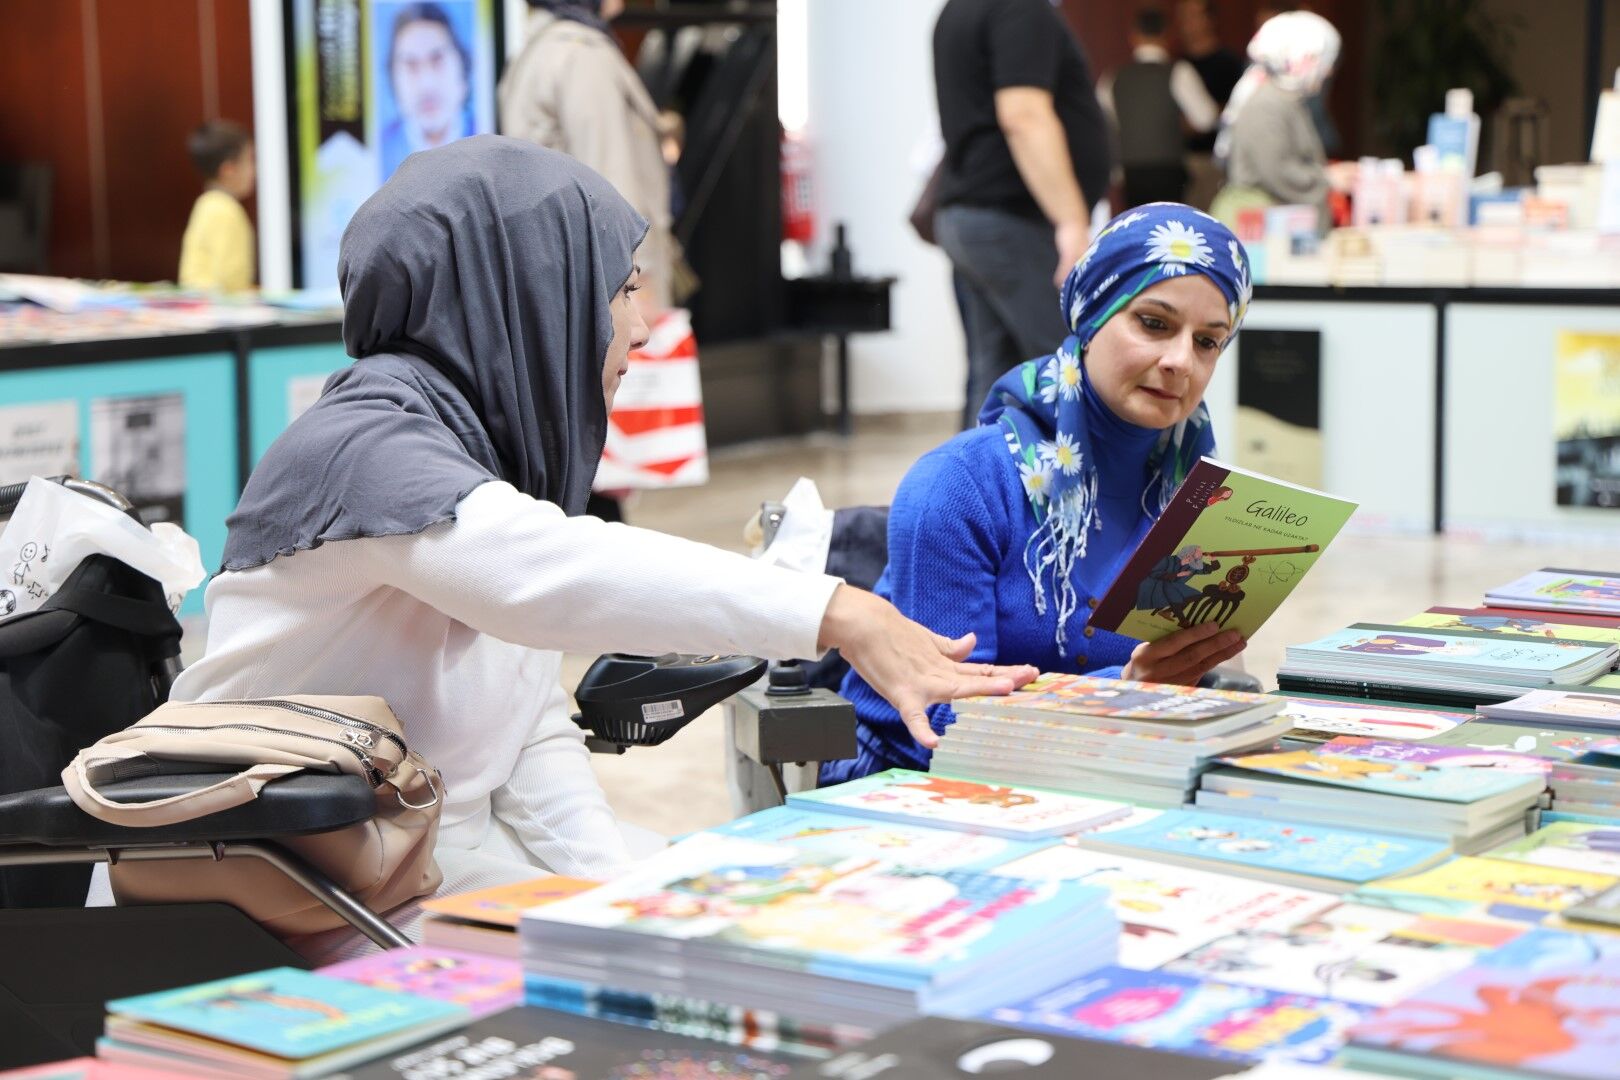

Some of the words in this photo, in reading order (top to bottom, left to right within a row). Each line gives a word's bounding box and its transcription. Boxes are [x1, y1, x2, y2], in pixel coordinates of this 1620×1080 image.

[1246, 499, 1309, 527] Galileo
[1224, 516, 1253, 528] YILDIZLAR
[1263, 527, 1283, 536] KADAR
